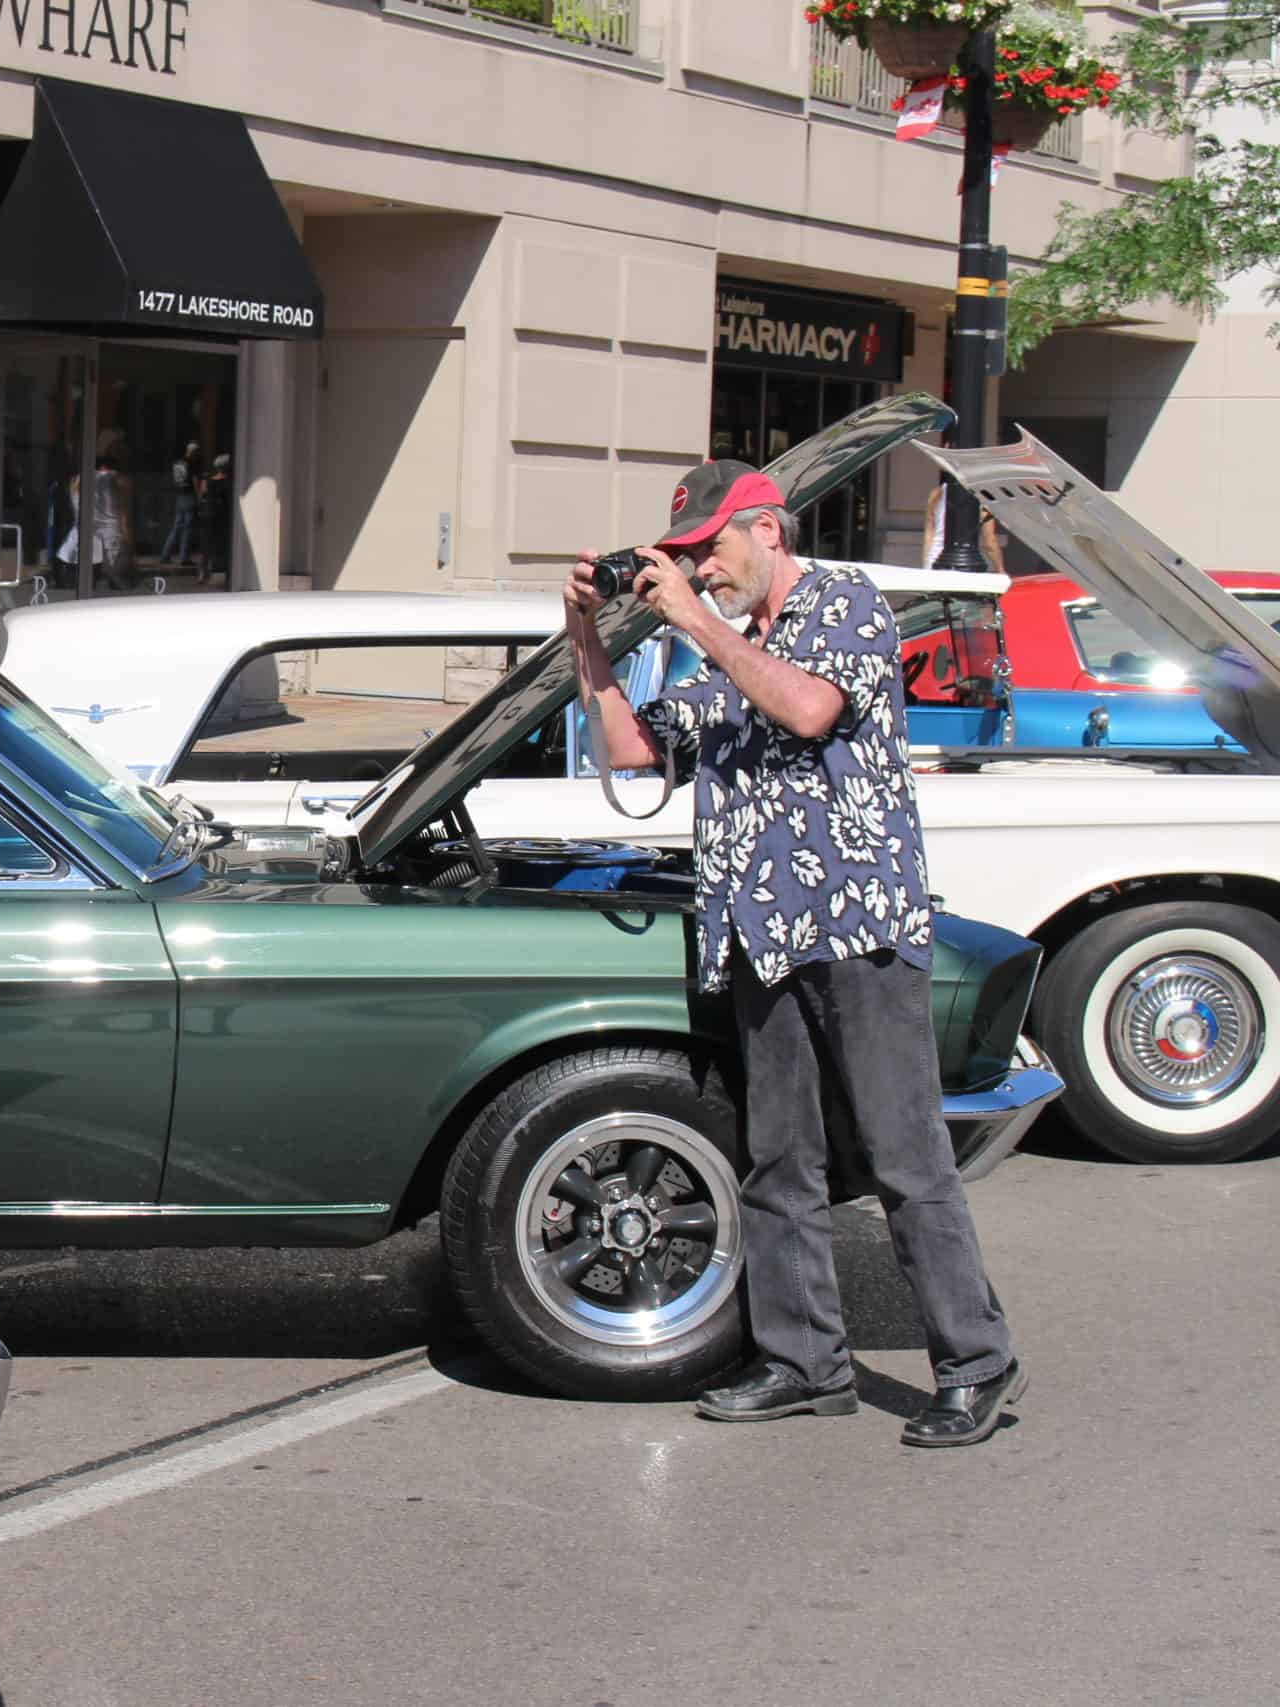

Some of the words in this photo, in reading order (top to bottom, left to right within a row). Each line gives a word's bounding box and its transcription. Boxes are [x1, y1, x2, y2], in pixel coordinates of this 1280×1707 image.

[138, 290, 175, 312] 1477
[178, 294, 269, 322] LAKESHORE
[272, 305, 314, 327] ROAD
[715, 313, 856, 362] HARMACY
